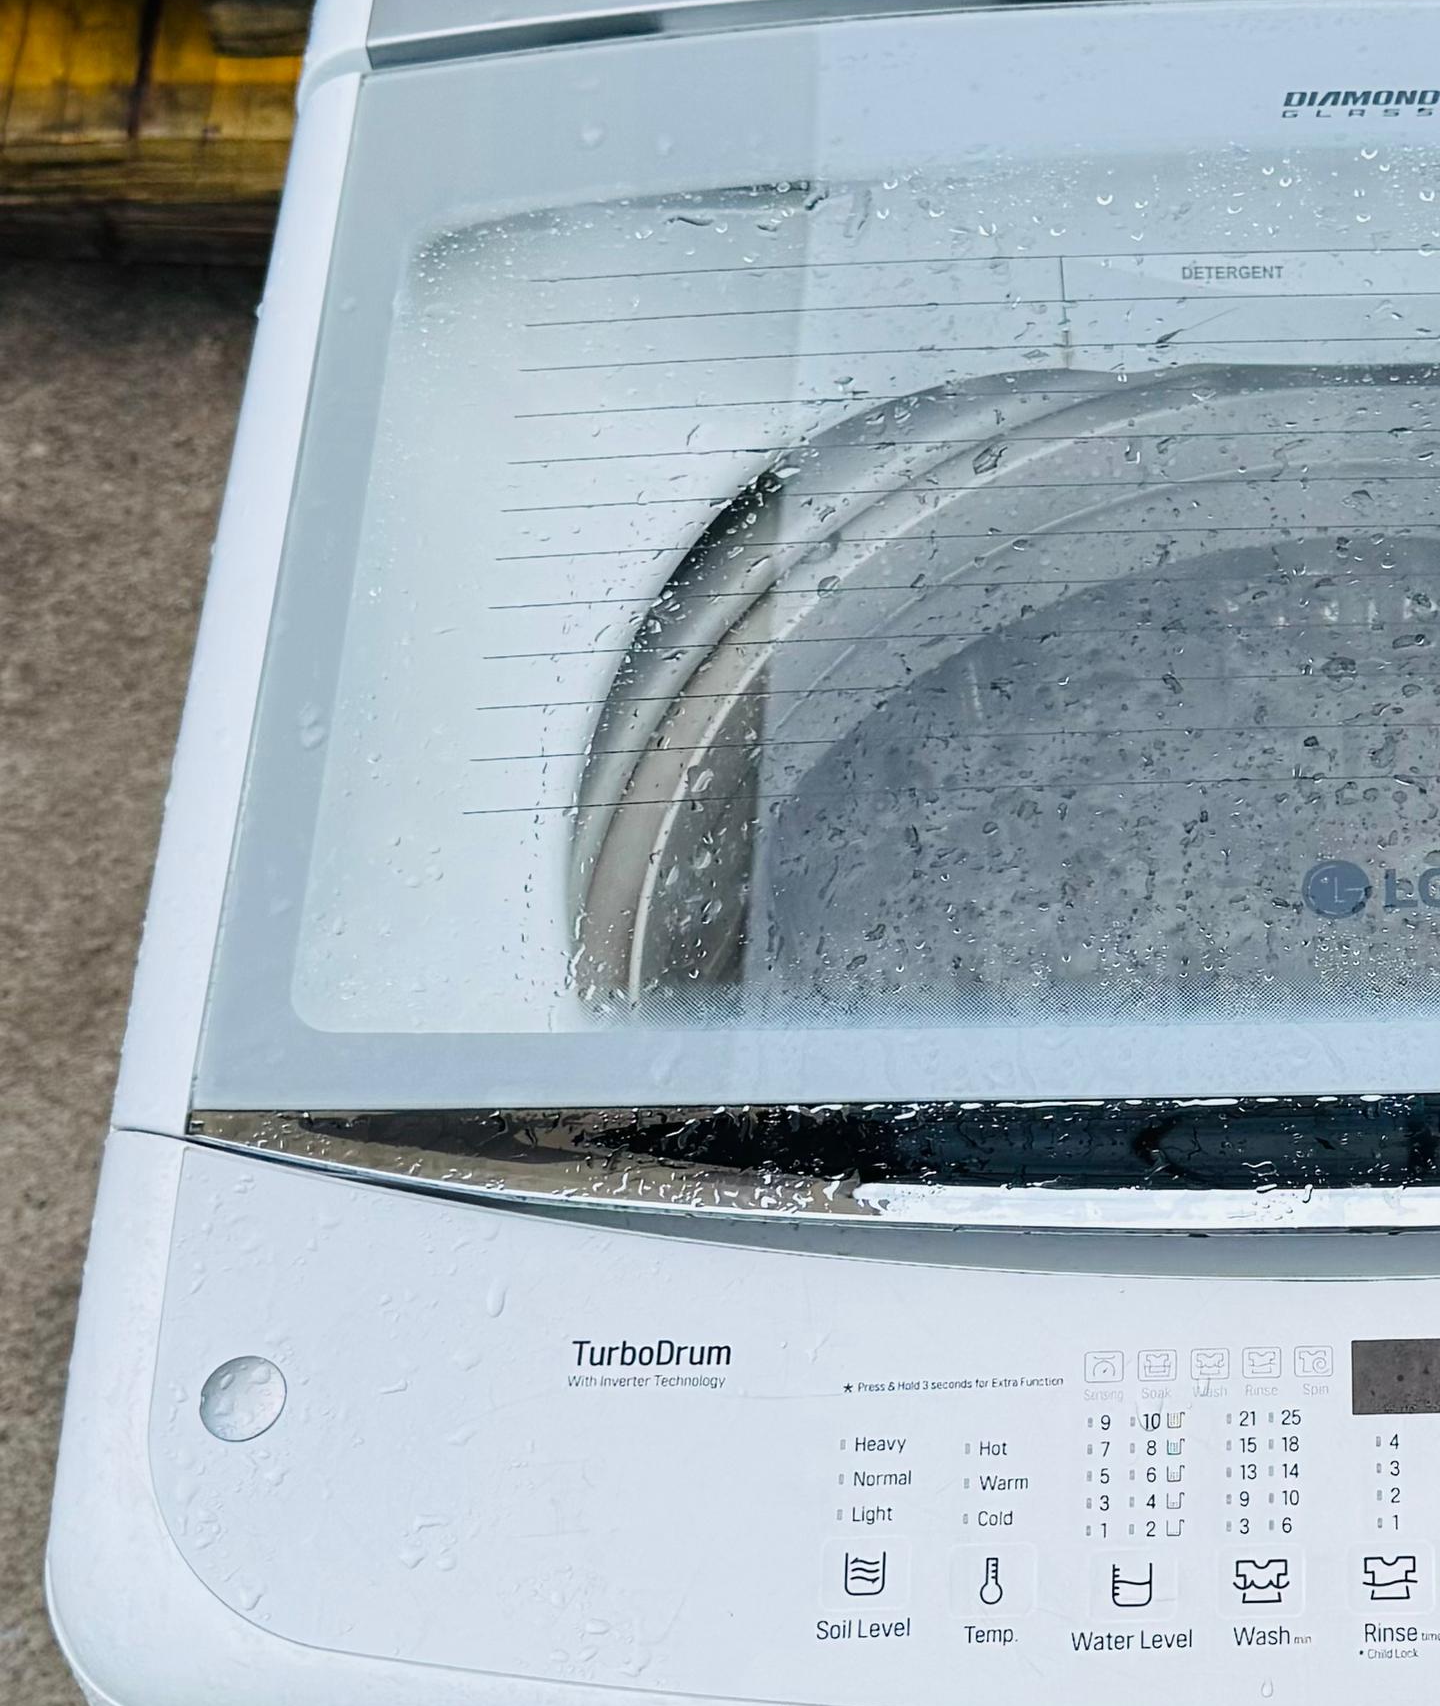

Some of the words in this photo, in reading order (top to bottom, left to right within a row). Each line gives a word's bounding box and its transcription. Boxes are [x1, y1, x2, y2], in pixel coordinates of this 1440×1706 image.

[1283, 90, 1440, 107] DIAMOND
[1281, 108, 1436, 118] GLASS
[1182, 265, 1284, 280] DETERGENT
[571, 1339, 732, 1367] TurboDrum
[568, 1375, 597, 1387] With
[601, 1375, 650, 1387] Inverter
[655, 1374, 726, 1389] Technology
[858, 1381, 885, 1392] Press
[887, 1381, 895, 1391] &
[898, 1380, 920, 1391] Hold
[922, 1380, 929, 1390] 3
[931, 1379, 972, 1390] seconds
[975, 1378, 988, 1388] for
[992, 1377, 1018, 1388] Extra
[1020, 1377, 1064, 1387] Function
[1303, 1383, 1329, 1396] Spin
[1141, 1388, 1171, 1399] Soak
[1245, 1385, 1278, 1397] Rinse
[1100, 1414, 1111, 1431] 9
[1143, 1412, 1161, 1431] 10
[1239, 1410, 1256, 1427] 21
[1281, 1409, 1302, 1426] 25
[855, 1436, 907, 1454] Heavy
[979, 1441, 1008, 1456] Hot
[1100, 1441, 1111, 1458] 7
[1146, 1439, 1157, 1456] 8
[1239, 1436, 1257, 1454] 15
[1281, 1435, 1300, 1453] 18
[1389, 1433, 1399, 1450] 4
[1100, 1467, 1110, 1485] 5
[1146, 1466, 1157, 1483] 6
[1240, 1463, 1257, 1480] 13
[1282, 1463, 1299, 1479] 14
[1390, 1460, 1401, 1477] 3
[853, 1469, 912, 1487] Normal
[979, 1475, 1029, 1491] Warm
[1099, 1494, 1110, 1512] 3
[1146, 1493, 1156, 1509] 4
[1239, 1490, 1250, 1508] 9
[1282, 1489, 1300, 1506] 10
[1390, 1487, 1401, 1504] 2
[852, 1506, 893, 1526] Light
[977, 1510, 1014, 1527] Cold
[1393, 1514, 1399, 1531] 1
[1100, 1522, 1107, 1539] 1
[1146, 1520, 1156, 1538] 2
[1239, 1518, 1250, 1535] 3
[1281, 1516, 1293, 1534] 6
[816, 1619, 852, 1640] Soil
[857, 1617, 911, 1639] Level
[963, 1624, 1020, 1646] Temp.
[1233, 1625, 1291, 1646] Wash
[1364, 1623, 1418, 1643] Rinse
[1071, 1631, 1135, 1652] Water
[1140, 1628, 1193, 1650] Level
[1367, 1648, 1393, 1659] Child
[1395, 1648, 1418, 1659] Lock
